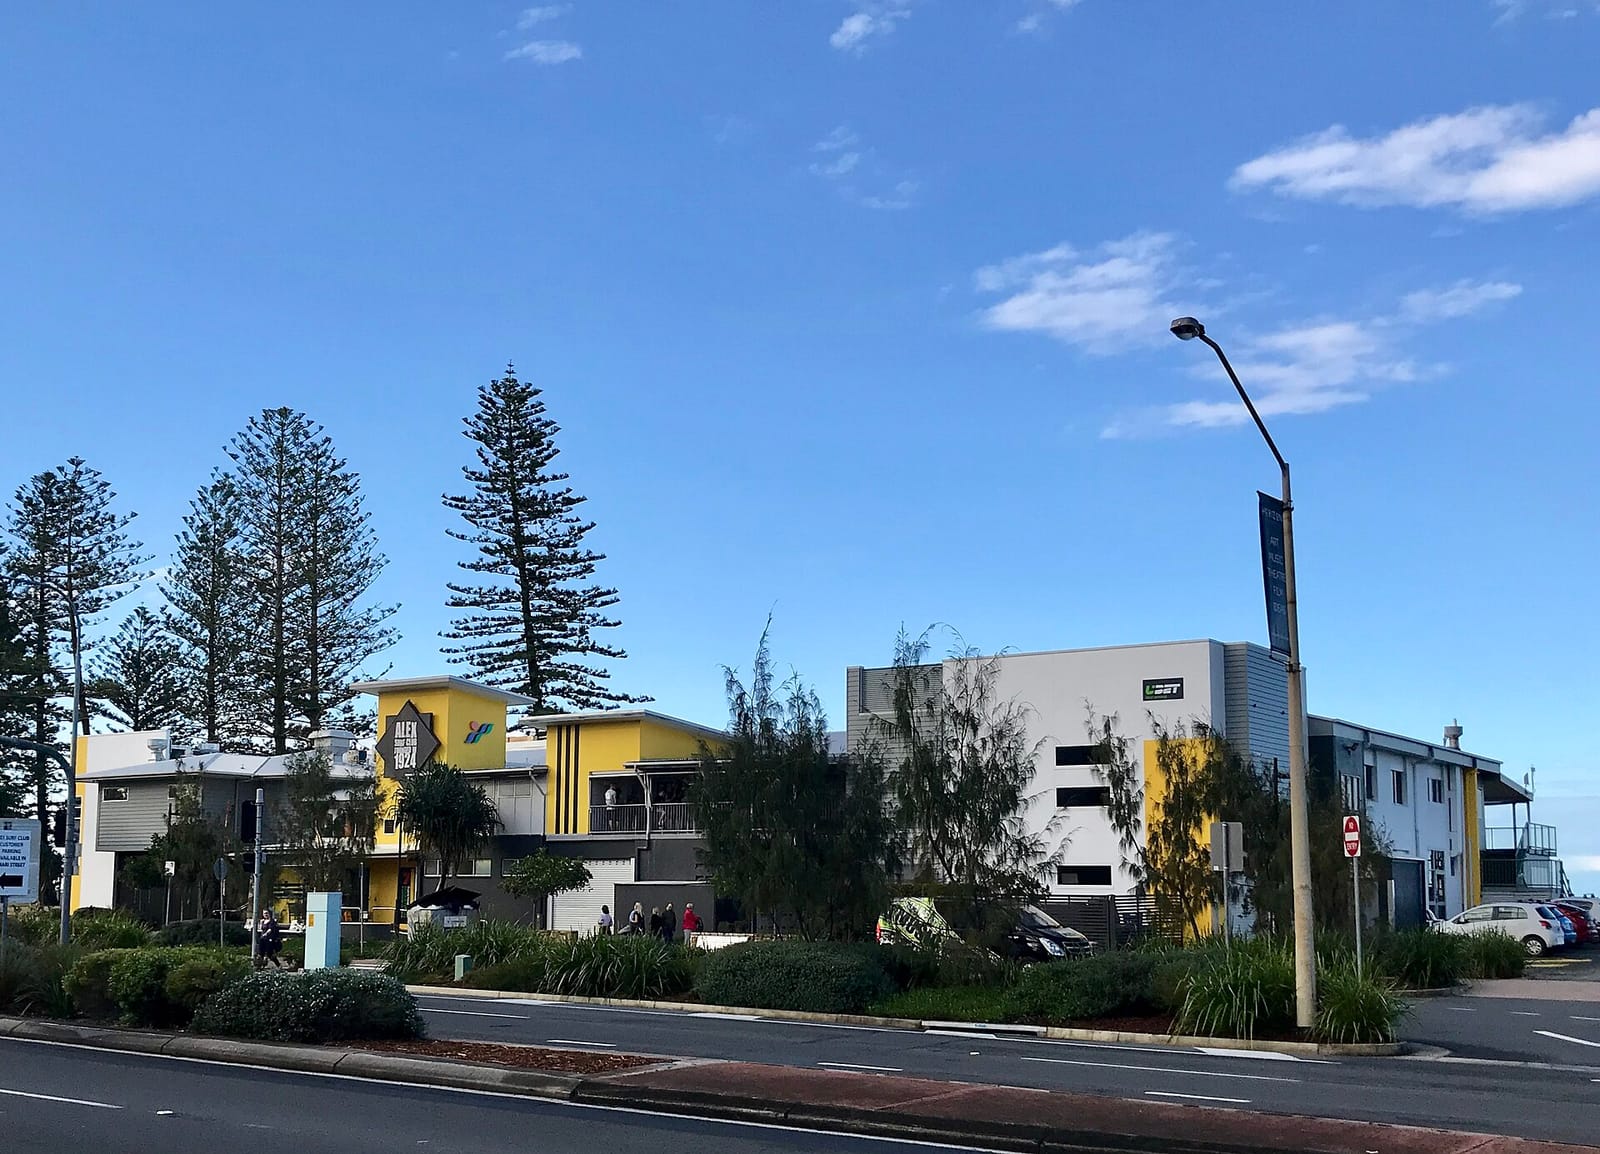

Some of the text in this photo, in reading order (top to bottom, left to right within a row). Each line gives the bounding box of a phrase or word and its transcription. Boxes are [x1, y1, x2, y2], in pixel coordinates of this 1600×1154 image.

[395, 721, 418, 738] ALEX
[405, 738, 418, 746] CLUB
[394, 752, 417, 770] 1924
[1348, 821, 1354, 830] NO
